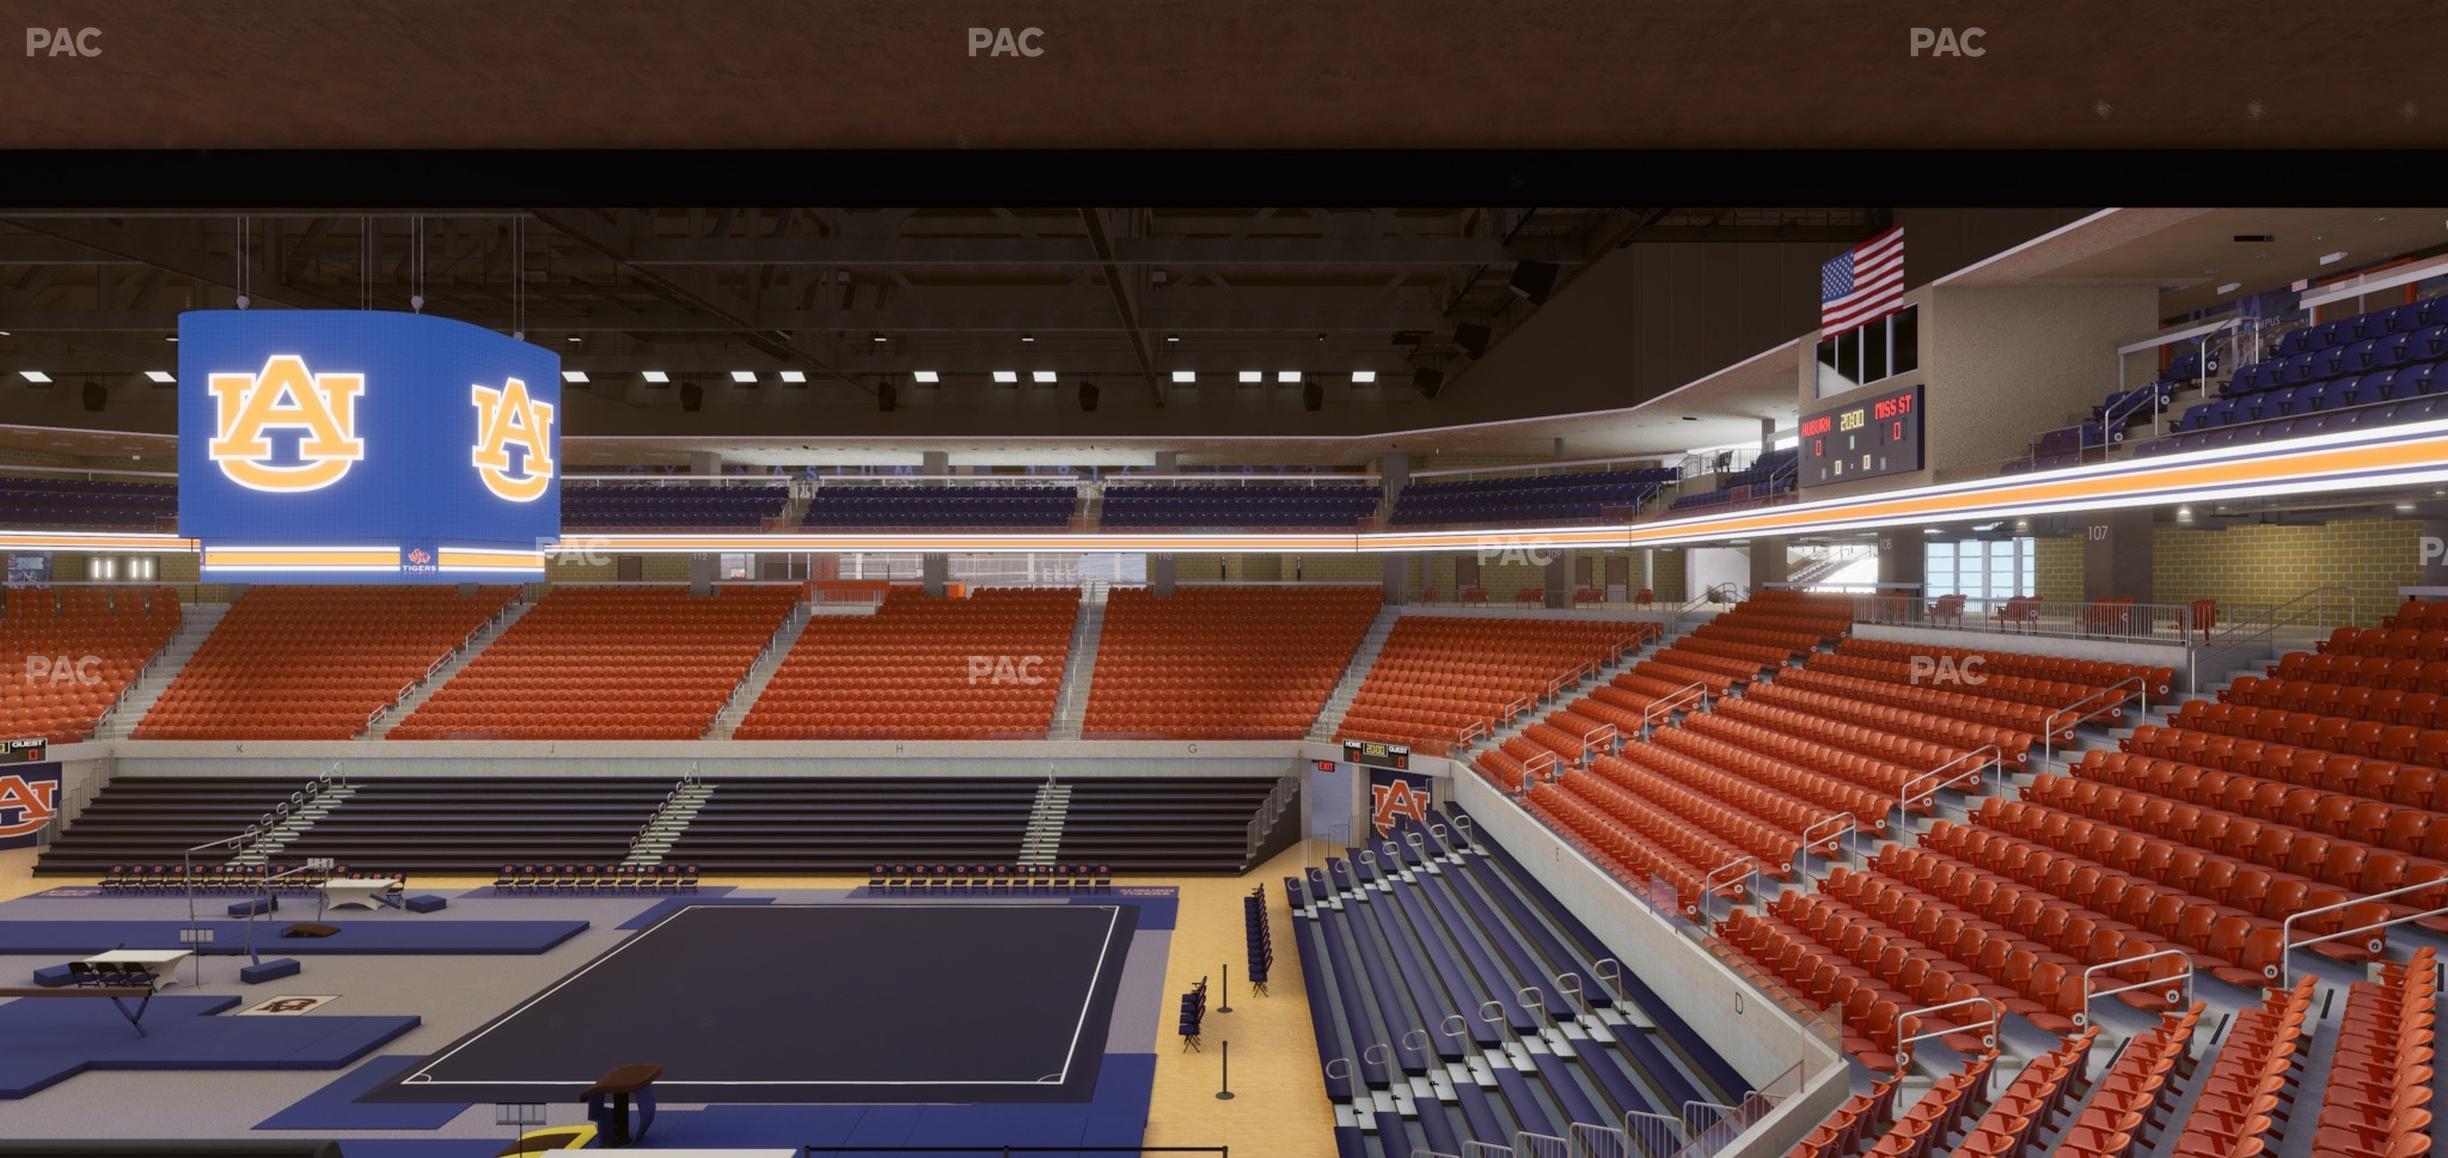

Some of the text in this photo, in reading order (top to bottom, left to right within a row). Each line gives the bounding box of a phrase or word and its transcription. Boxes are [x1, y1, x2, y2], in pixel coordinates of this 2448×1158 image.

[1898, 394, 1912, 414] ST
[1801, 416, 1831, 437] AUBURN
[1841, 409, 1864, 432] 20:00
[2088, 525, 2108, 541] 107
[1880, 538, 1892, 550] 108
[12, 740, 43, 748] GUEST
[236, 743, 244, 753] K
[895, 743, 904, 753] H
[1187, 743, 1198, 754] G
[1319, 761, 1333, 772] EXIT
[1734, 991, 1744, 1015] D
